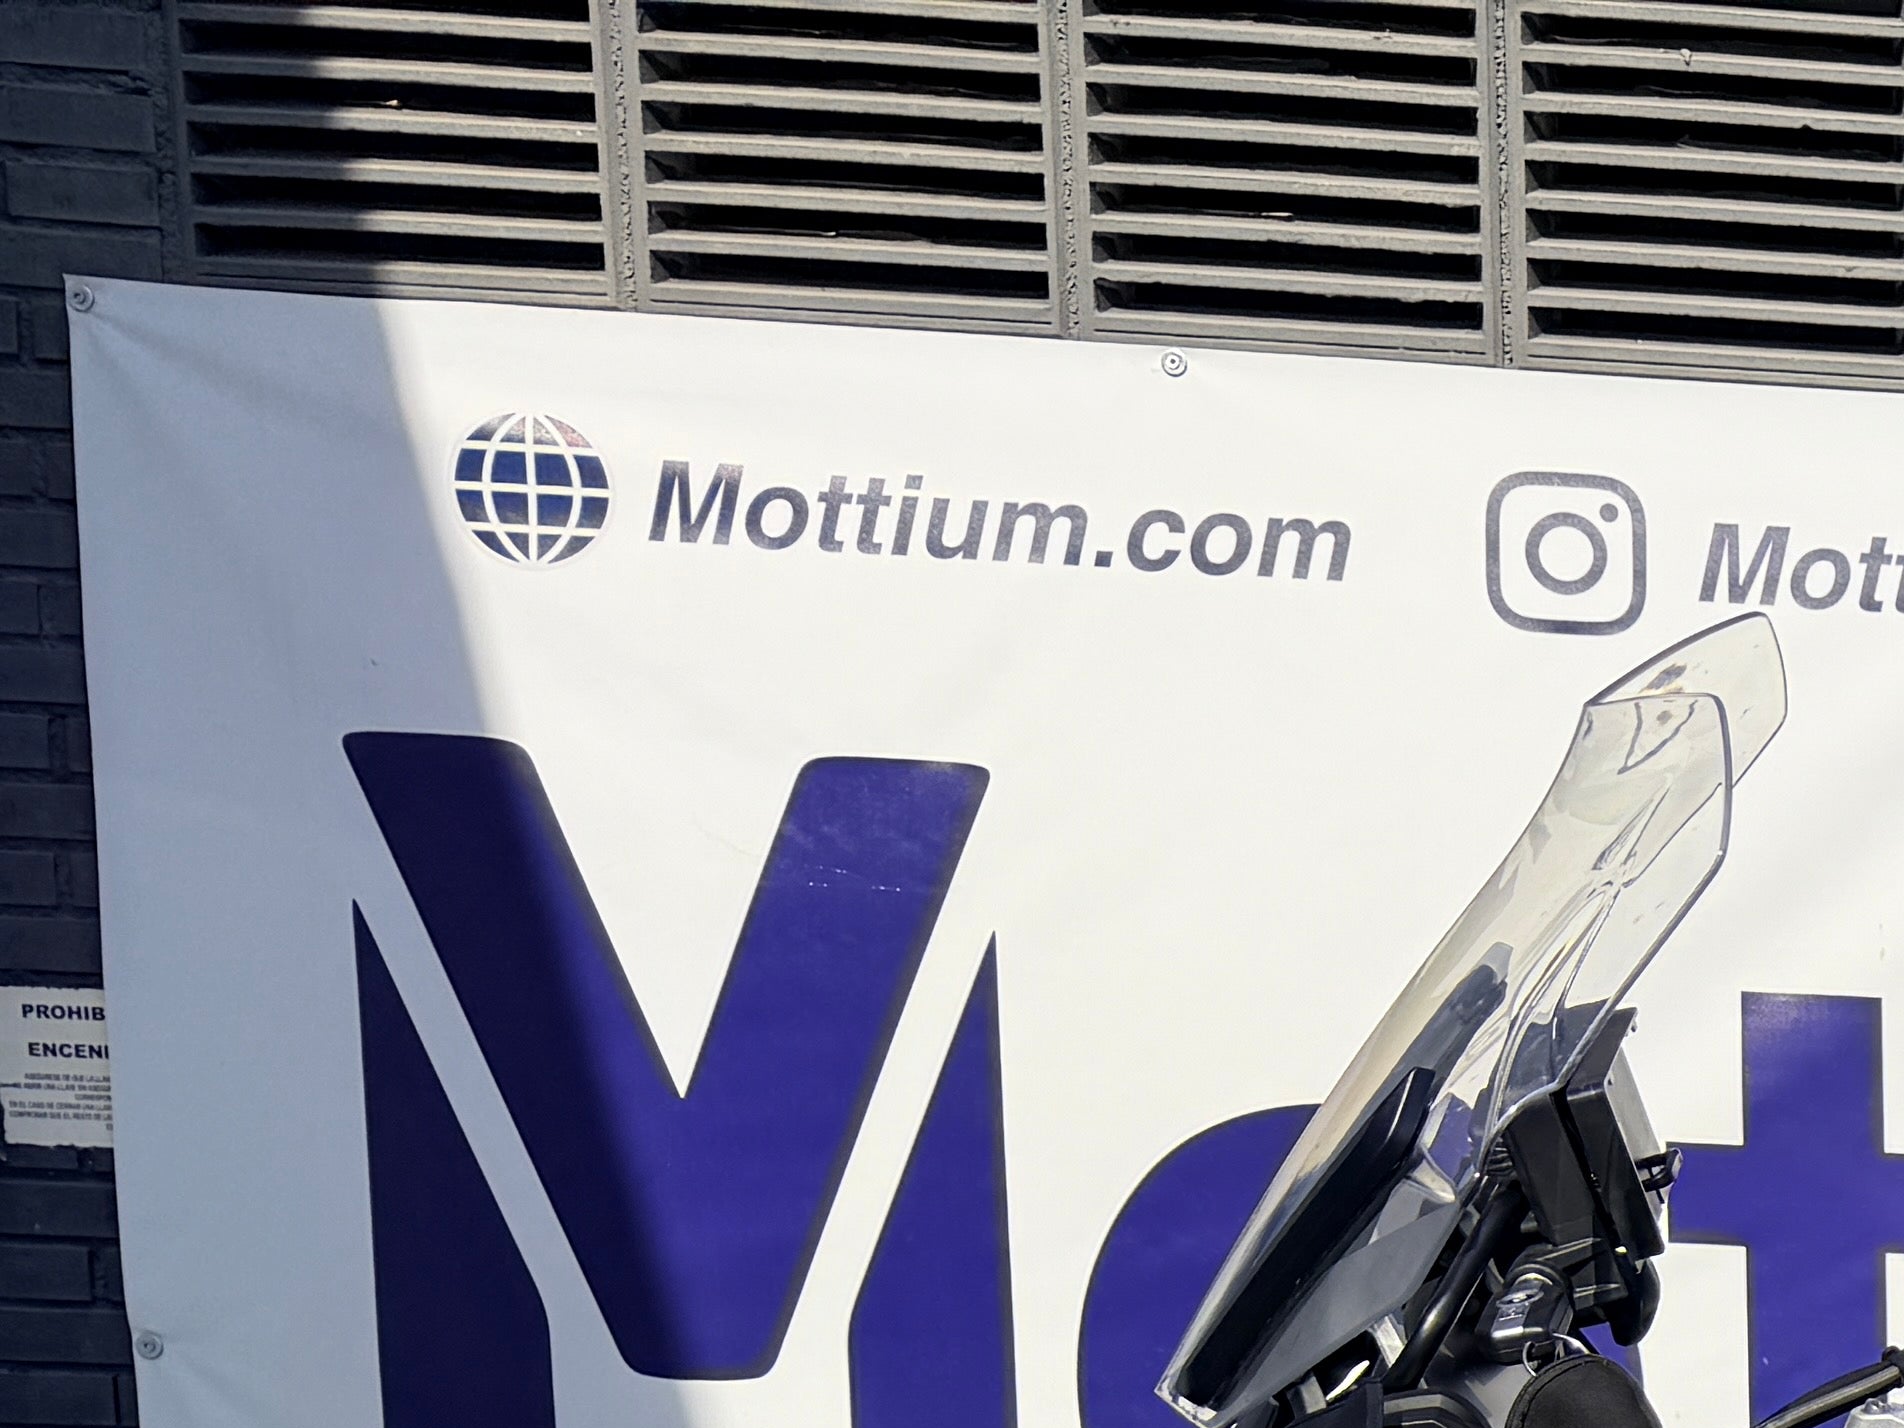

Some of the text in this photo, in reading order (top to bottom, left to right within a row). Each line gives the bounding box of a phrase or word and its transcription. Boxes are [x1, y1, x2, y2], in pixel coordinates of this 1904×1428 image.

[647, 459, 1353, 582] Mottium.com
[21, 1003, 106, 1021] PROHIB
[28, 1041, 110, 1059] ENCEN
